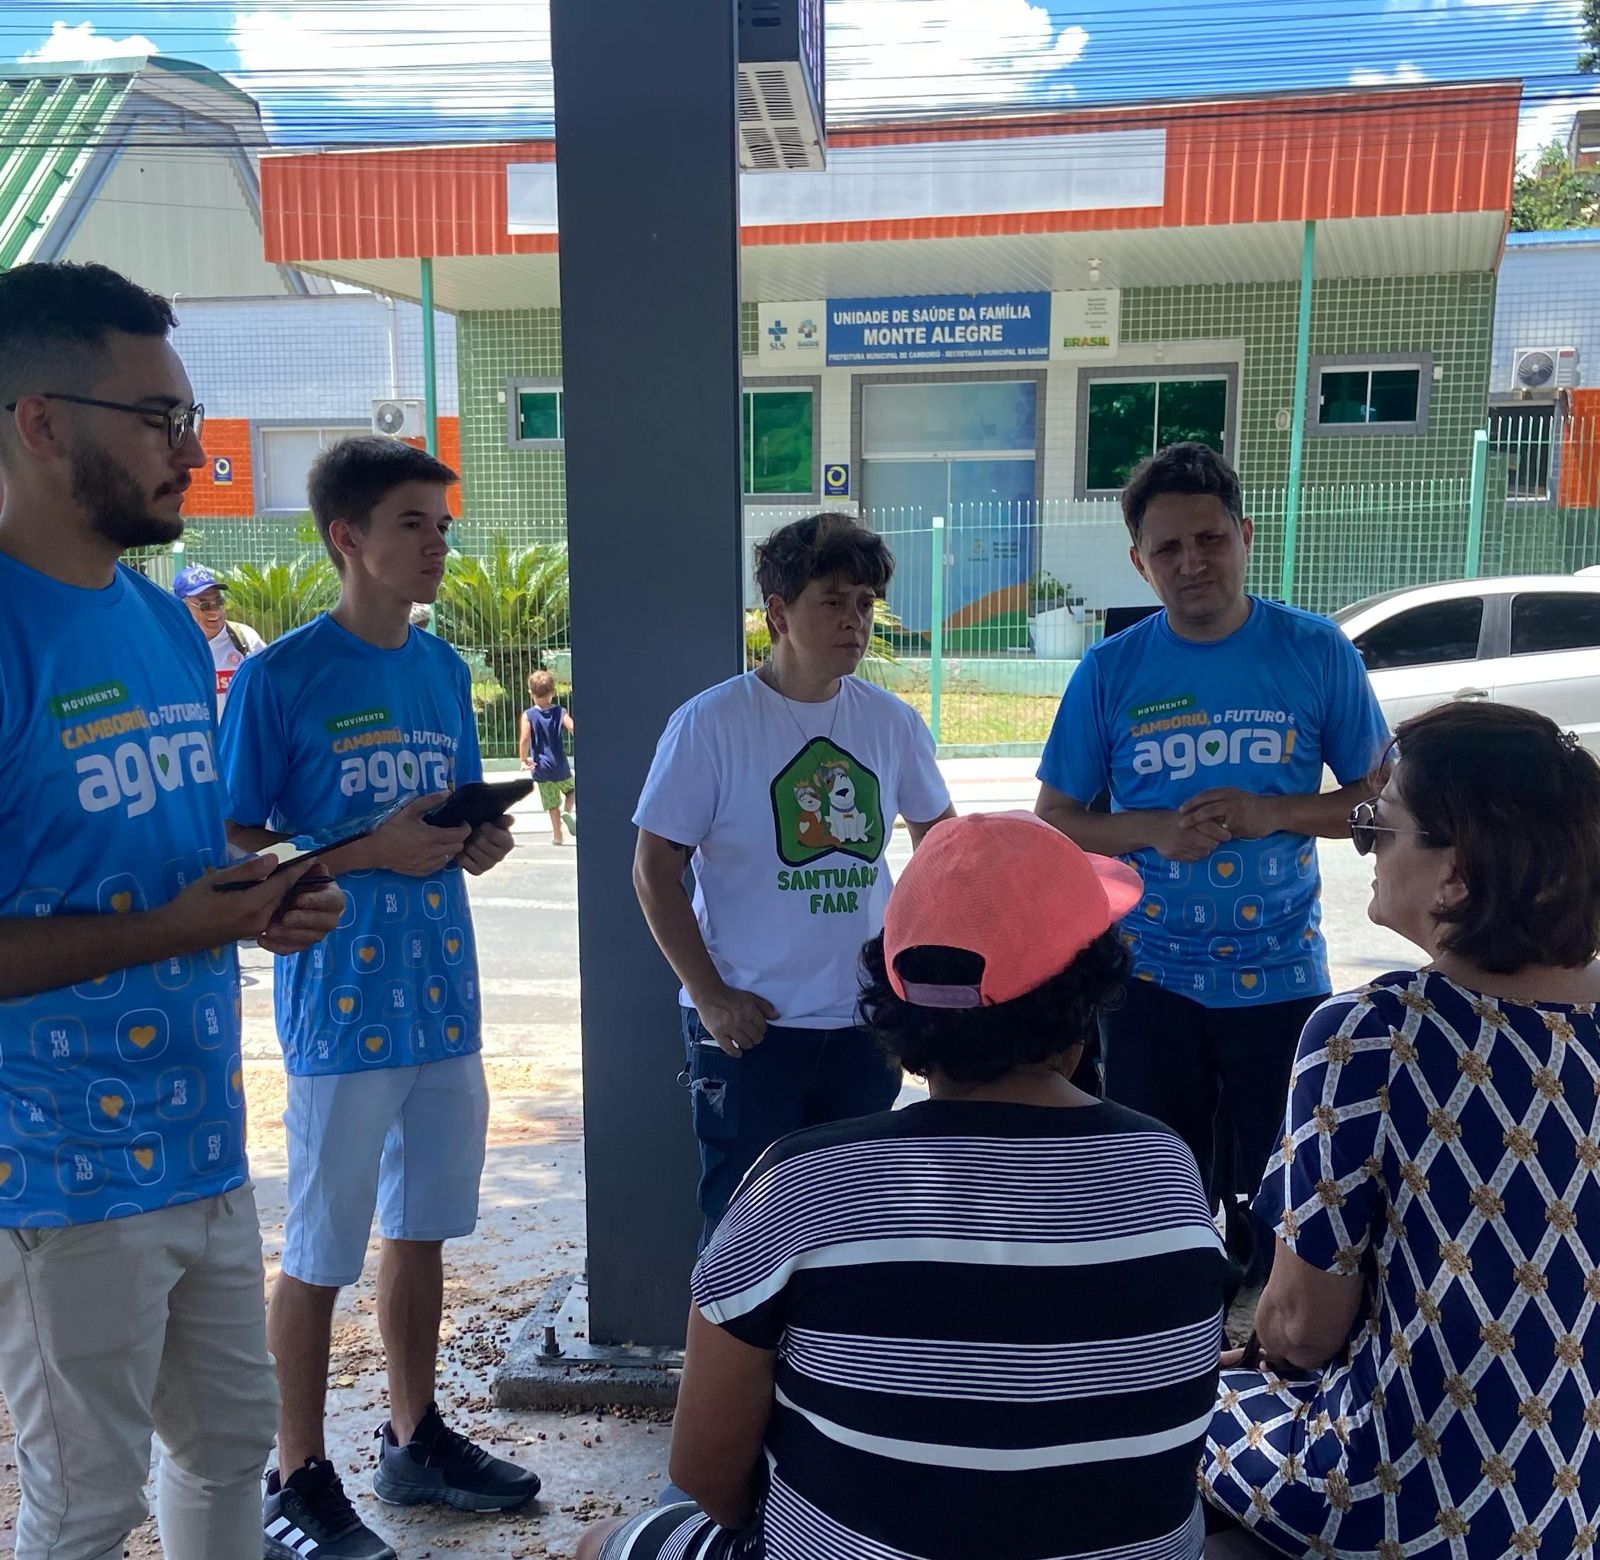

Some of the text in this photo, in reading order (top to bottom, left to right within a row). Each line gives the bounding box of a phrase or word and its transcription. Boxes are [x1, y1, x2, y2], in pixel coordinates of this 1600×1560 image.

[833, 303, 1031, 325] UNIDADE DE SAÚDE DA FAMÍLIA
[863, 325, 1003, 346] MONTE ALEGRE
[1063, 336, 1110, 347] BRASIL
[769, 342, 786, 351] SUS
[62, 687, 120, 713] MOVIMENTO
[1137, 698, 1188, 716] MOVIMENTO
[336, 712, 385, 729] MOVIMENTO
[1224, 709, 1286, 724] FUTURO
[1132, 728, 1297, 781] agora!
[810, 891, 858, 914] FAAR
